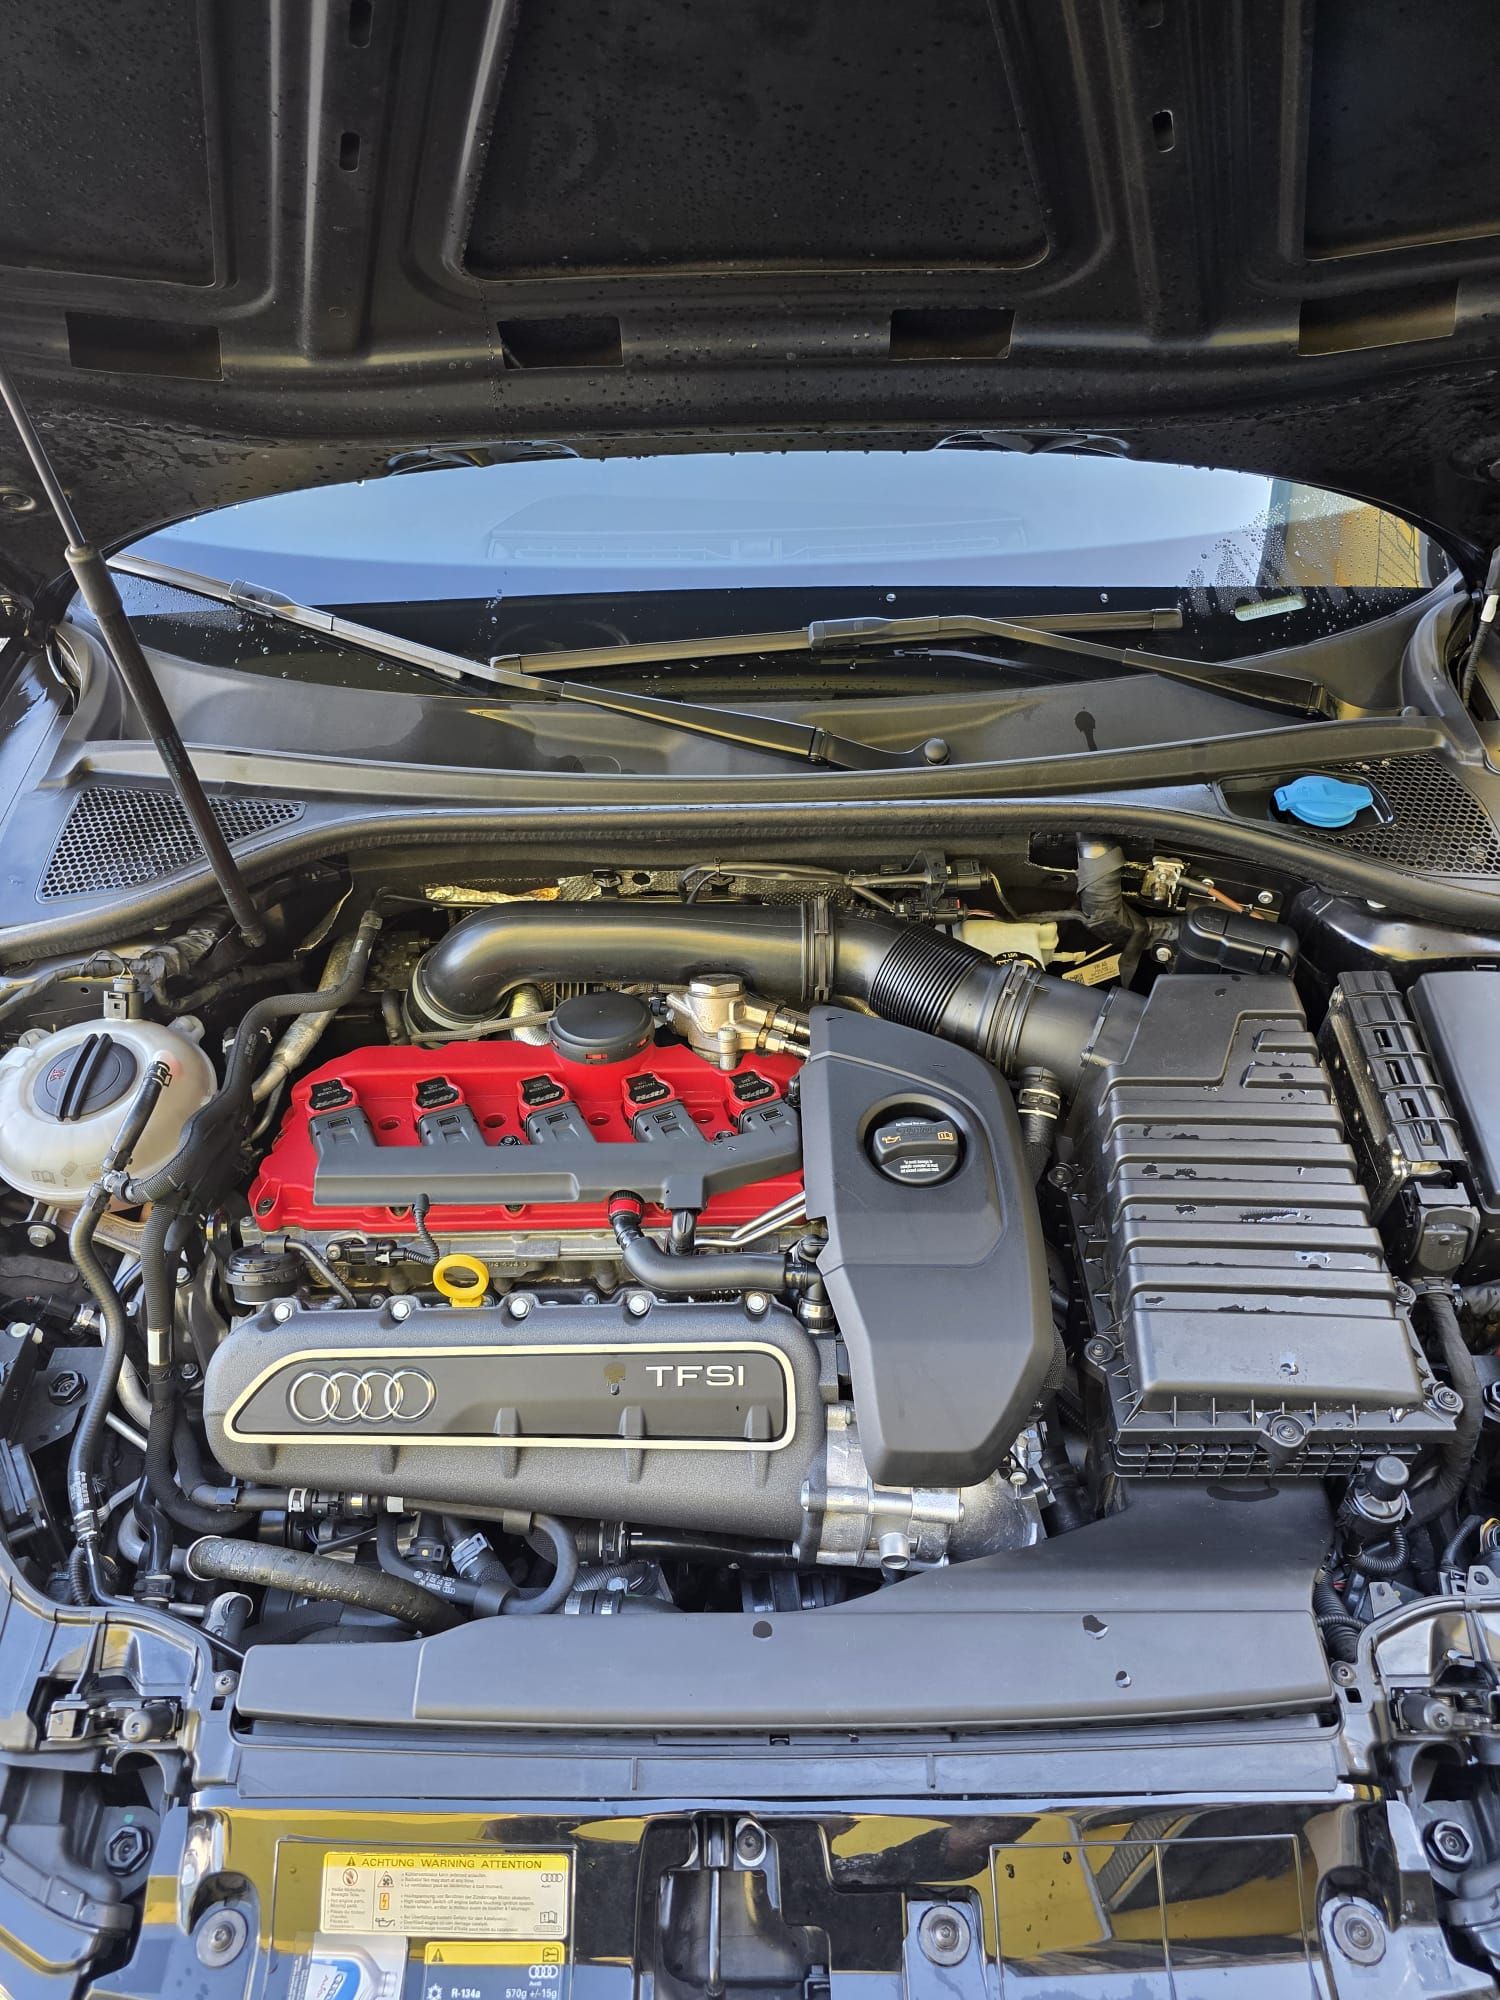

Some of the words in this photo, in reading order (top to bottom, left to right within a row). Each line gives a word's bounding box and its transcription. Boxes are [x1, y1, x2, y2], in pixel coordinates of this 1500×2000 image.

[645, 1365, 744, 1387] TFSI
[362, 1858, 415, 1867] ACHTUNG
[420, 1859, 475, 1868] WARNING
[481, 1860, 542, 1869] ATTENTION
[451, 1987, 481, 1998] R-134a
[505, 1988, 527, 2000] 570g
[529, 1988, 558, 2000] +/-15g
